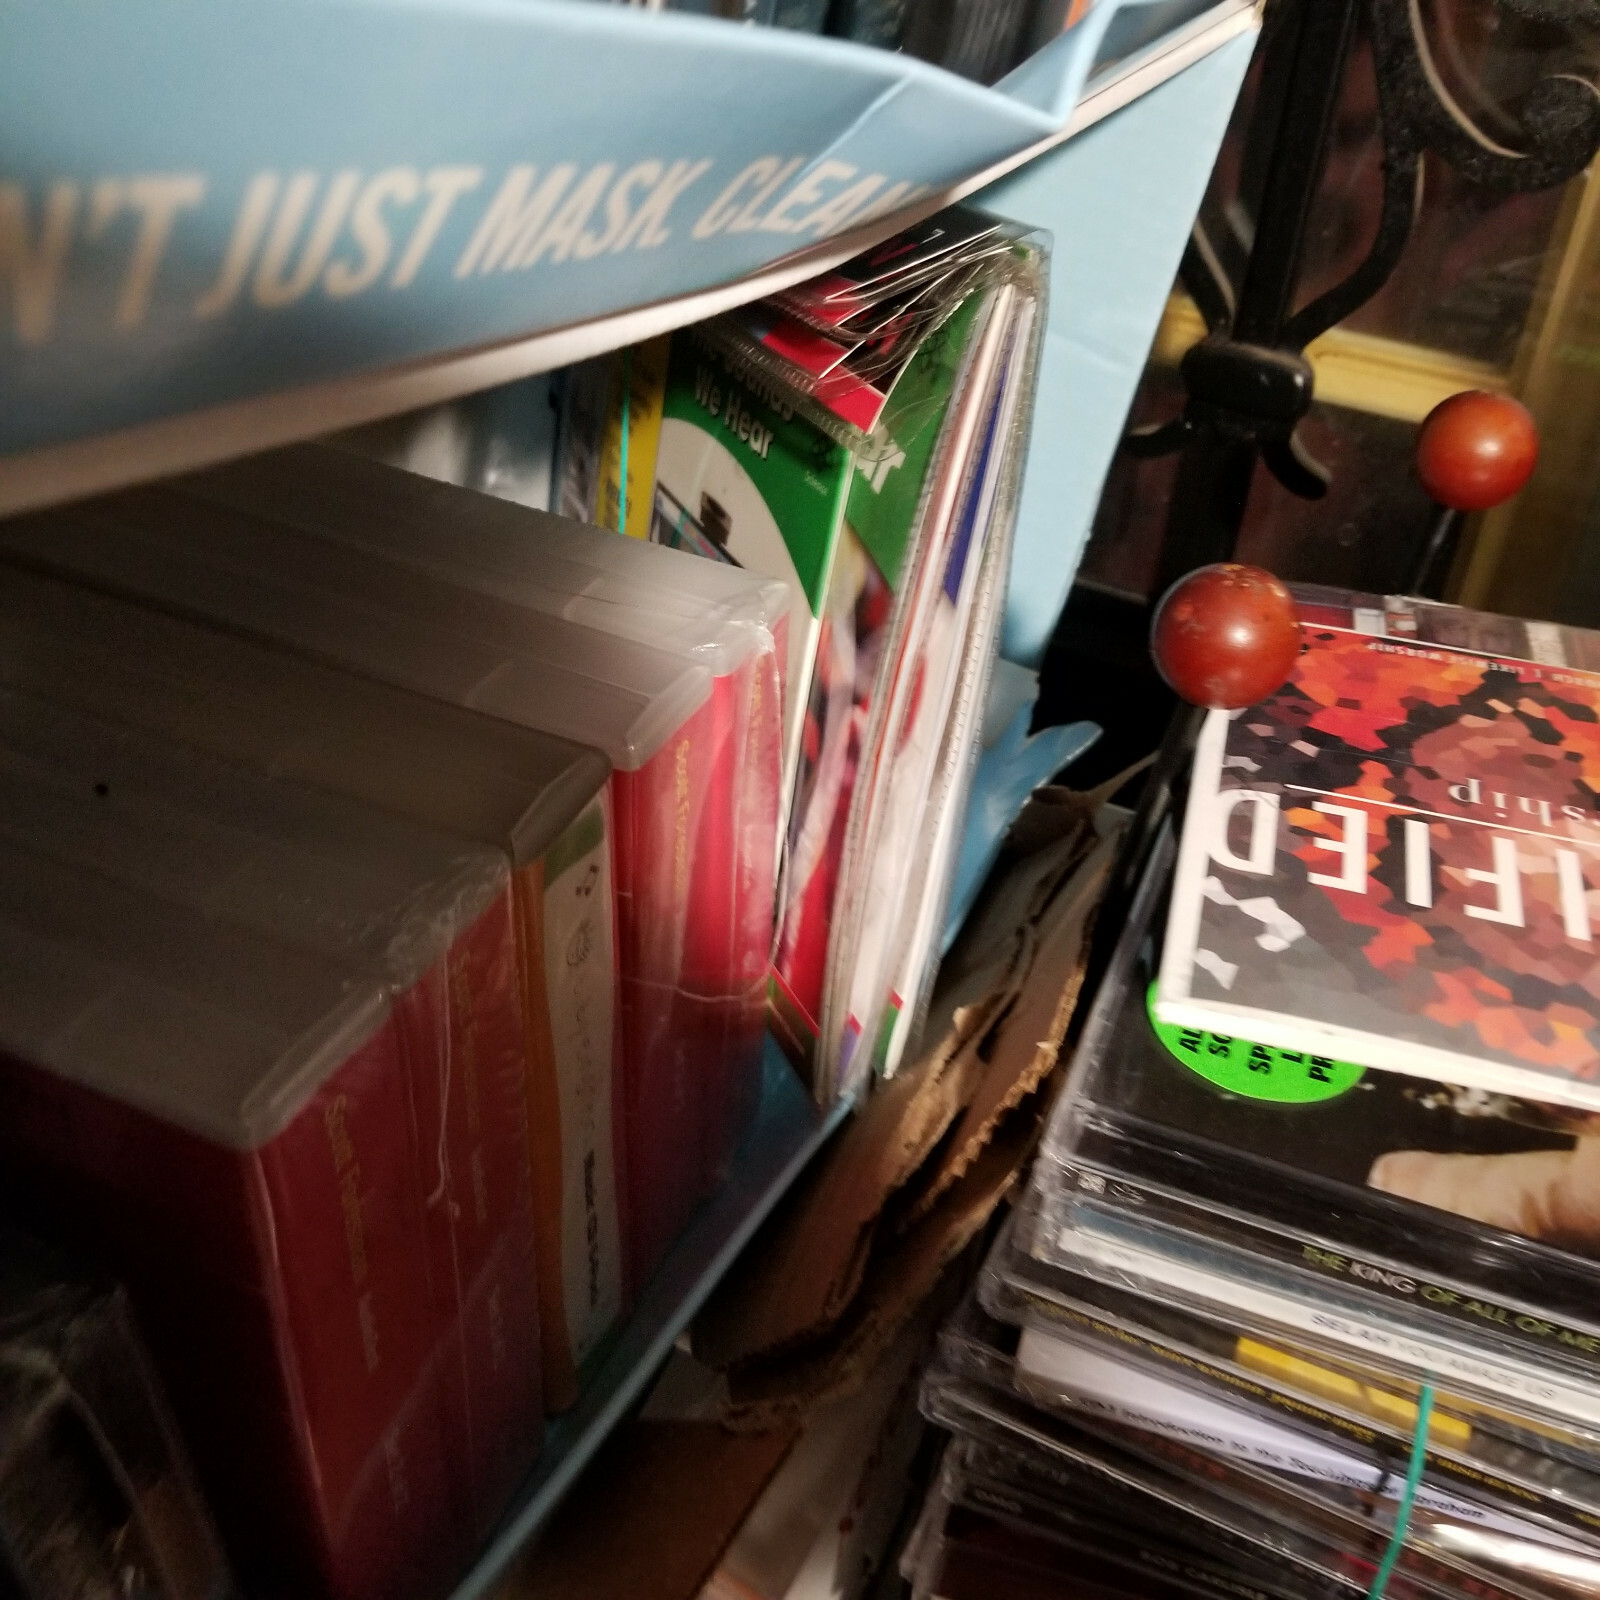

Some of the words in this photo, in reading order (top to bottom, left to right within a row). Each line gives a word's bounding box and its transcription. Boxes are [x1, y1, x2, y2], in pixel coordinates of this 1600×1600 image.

[193, 165, 483, 322] JUST
[725, 388, 775, 460] Hear
[1367, 641, 1442, 662] WORSHIP
[1447, 777, 1600, 828] ship
[1248, 1041, 1274, 1075] SP
[1301, 1244, 1348, 1272] THE
[1349, 1261, 1418, 1294] KING
[1420, 1284, 1463, 1305] OF
[1461, 1302, 1511, 1328] ALL
[1514, 1316, 1558, 1337] OF
[1556, 1330, 1600, 1354] ME
[1311, 1311, 1391, 1345] SELAH
